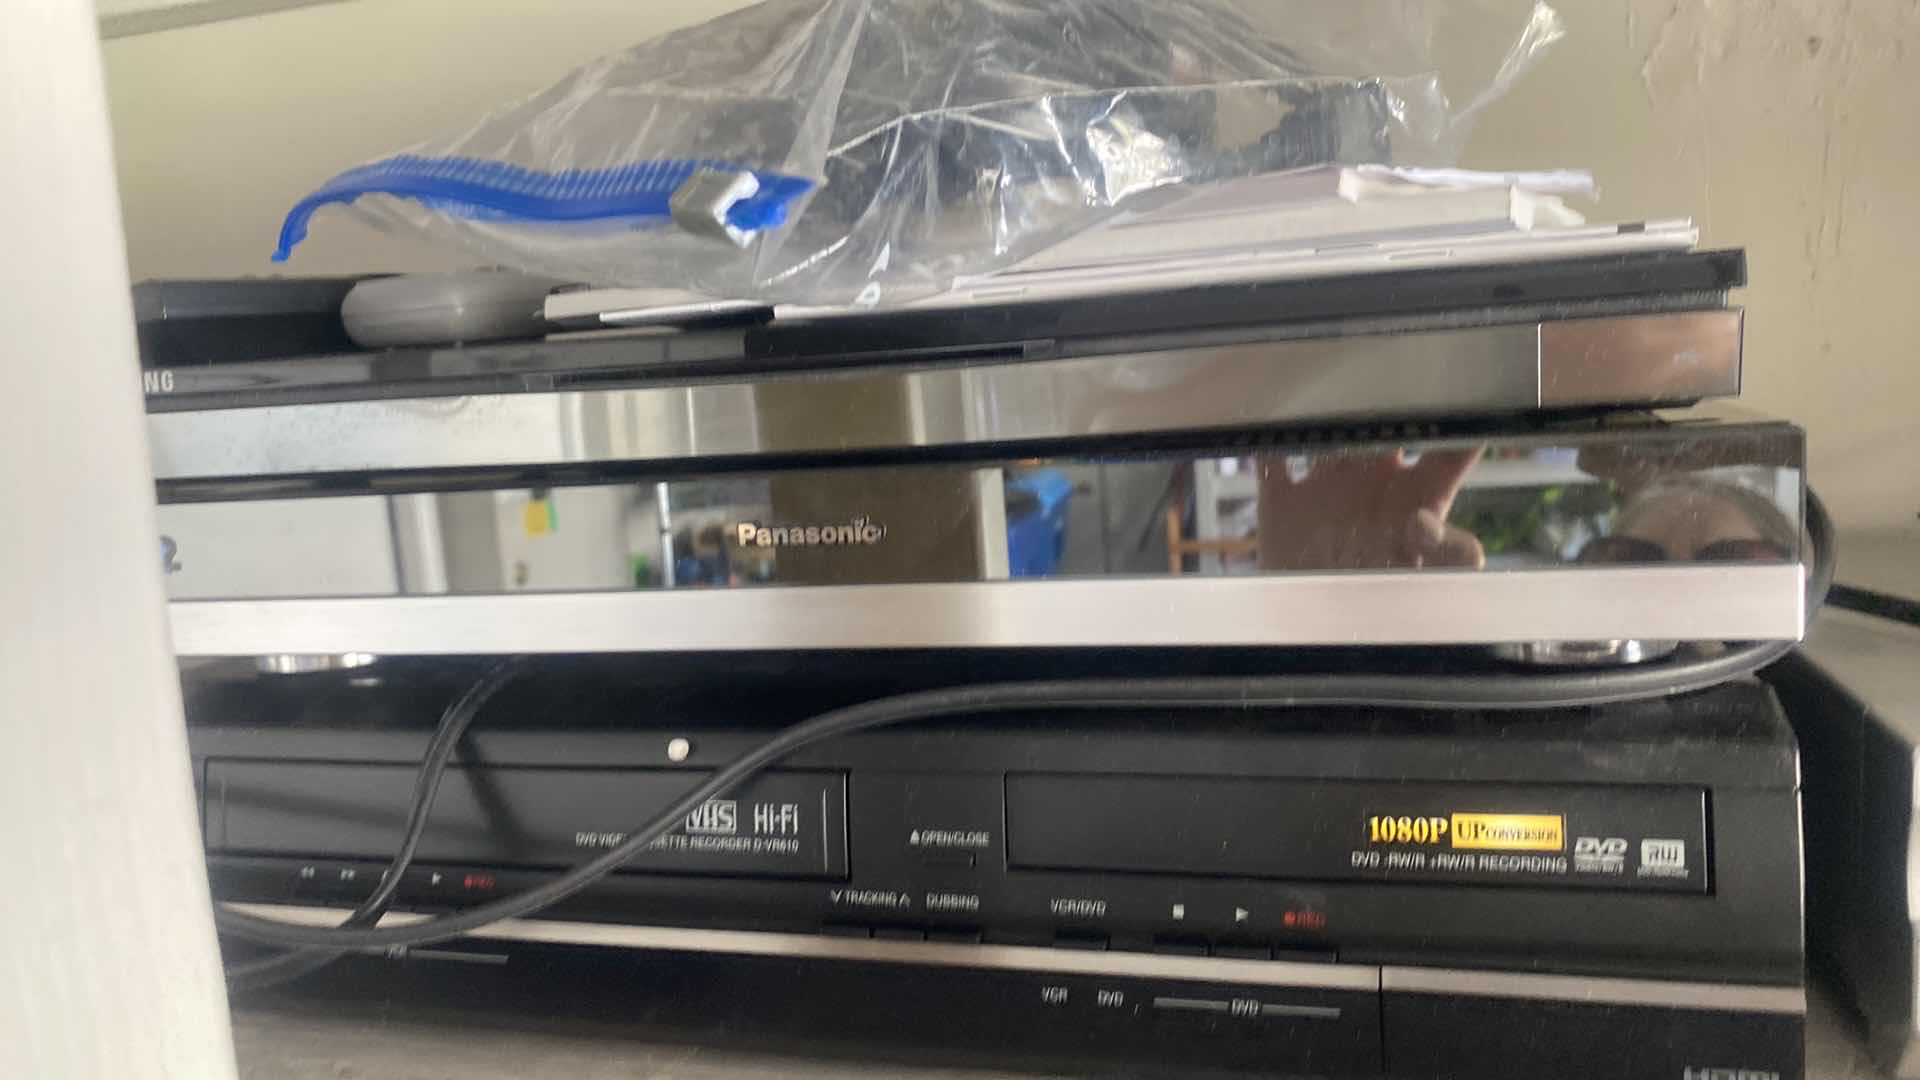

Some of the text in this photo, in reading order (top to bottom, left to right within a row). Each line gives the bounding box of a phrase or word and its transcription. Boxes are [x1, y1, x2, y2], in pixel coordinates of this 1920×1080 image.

[737, 518, 878, 547] Panasonic
[686, 802, 734, 829] VHS
[920, 829, 991, 847] OPEN/CLOSE
[1370, 815, 1448, 844] 1080P
[690, 835, 750, 852] RECORDER
[1575, 837, 1628, 857] DVD
[1351, 851, 1381, 869] DVD
[1478, 854, 1569, 874] RECORDING
[845, 888, 897, 908] TRACKING
[926, 892, 981, 911] DUBBING
[1050, 898, 1107, 917] VCR/DVD
[1041, 985, 1069, 1004] VCR
[1097, 988, 1125, 1008] DVD
[1231, 998, 1259, 1017] DVD
